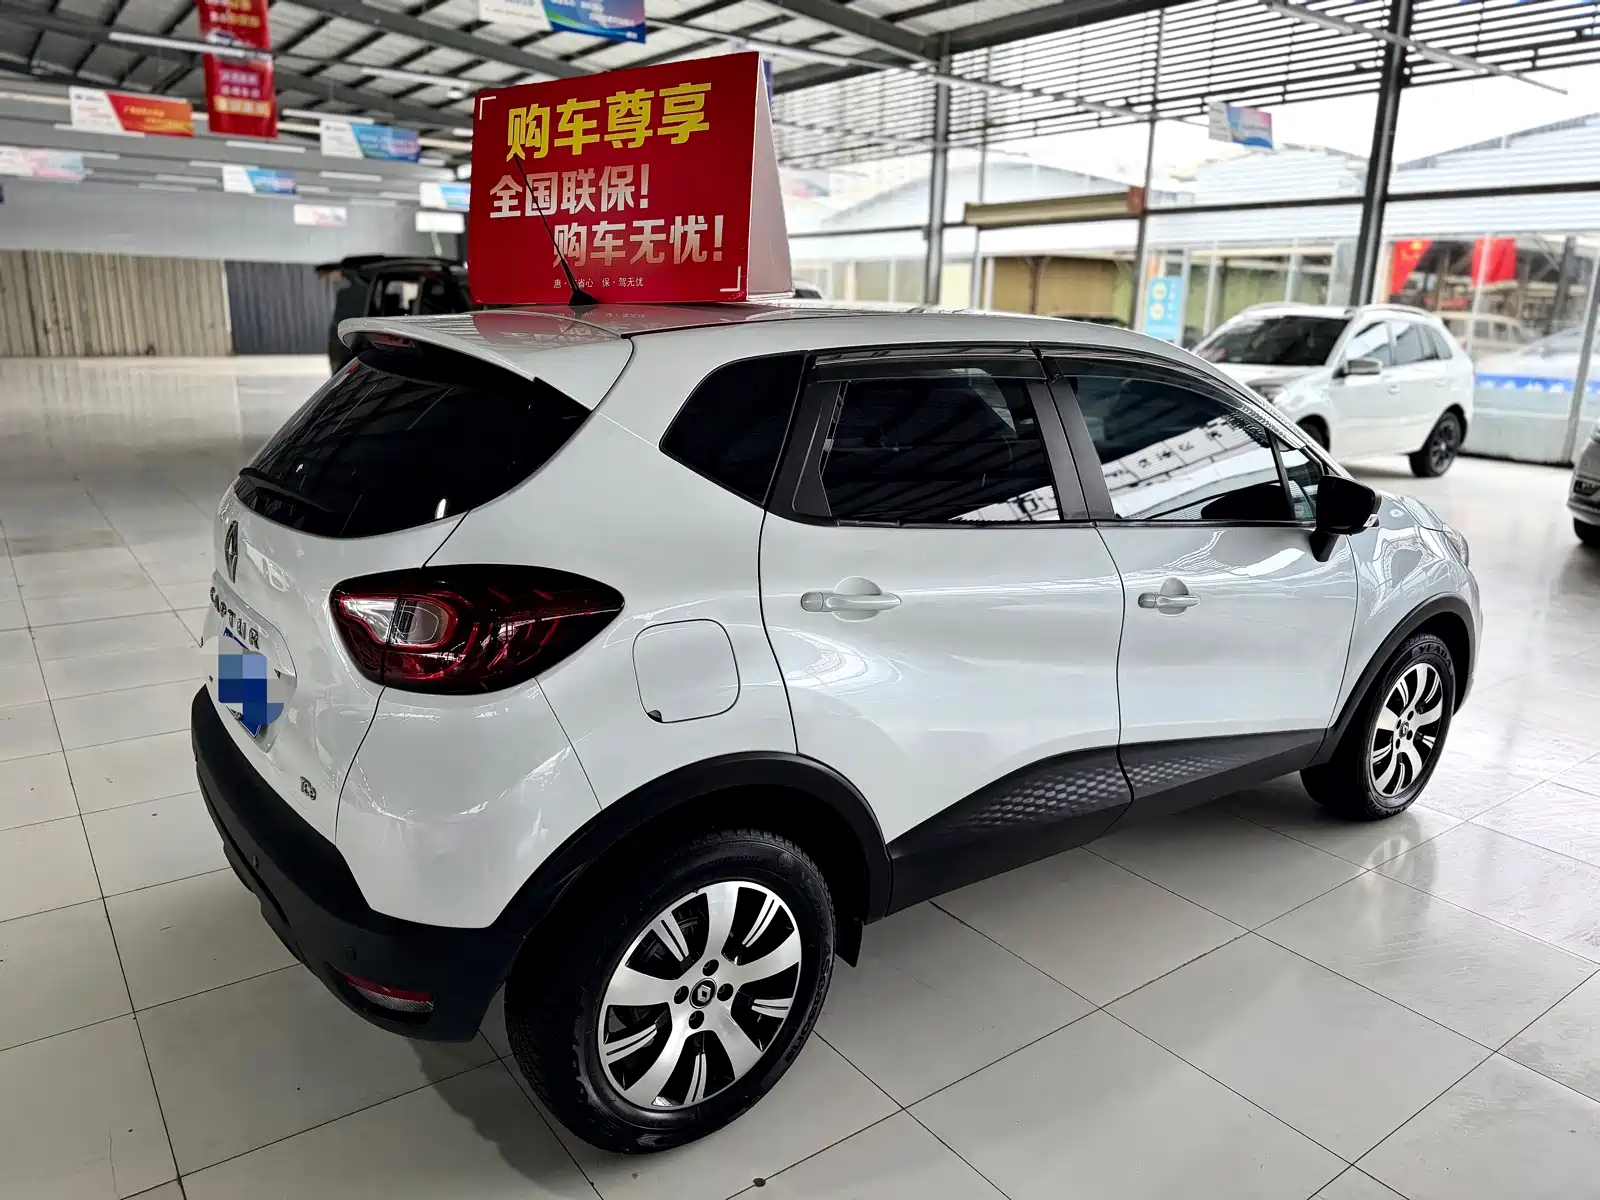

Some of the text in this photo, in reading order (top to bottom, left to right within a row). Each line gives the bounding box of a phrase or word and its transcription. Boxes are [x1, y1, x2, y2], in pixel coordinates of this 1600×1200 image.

[506, 82, 712, 162] 购车尊享
[209, 586, 260, 650] CAPTUR
